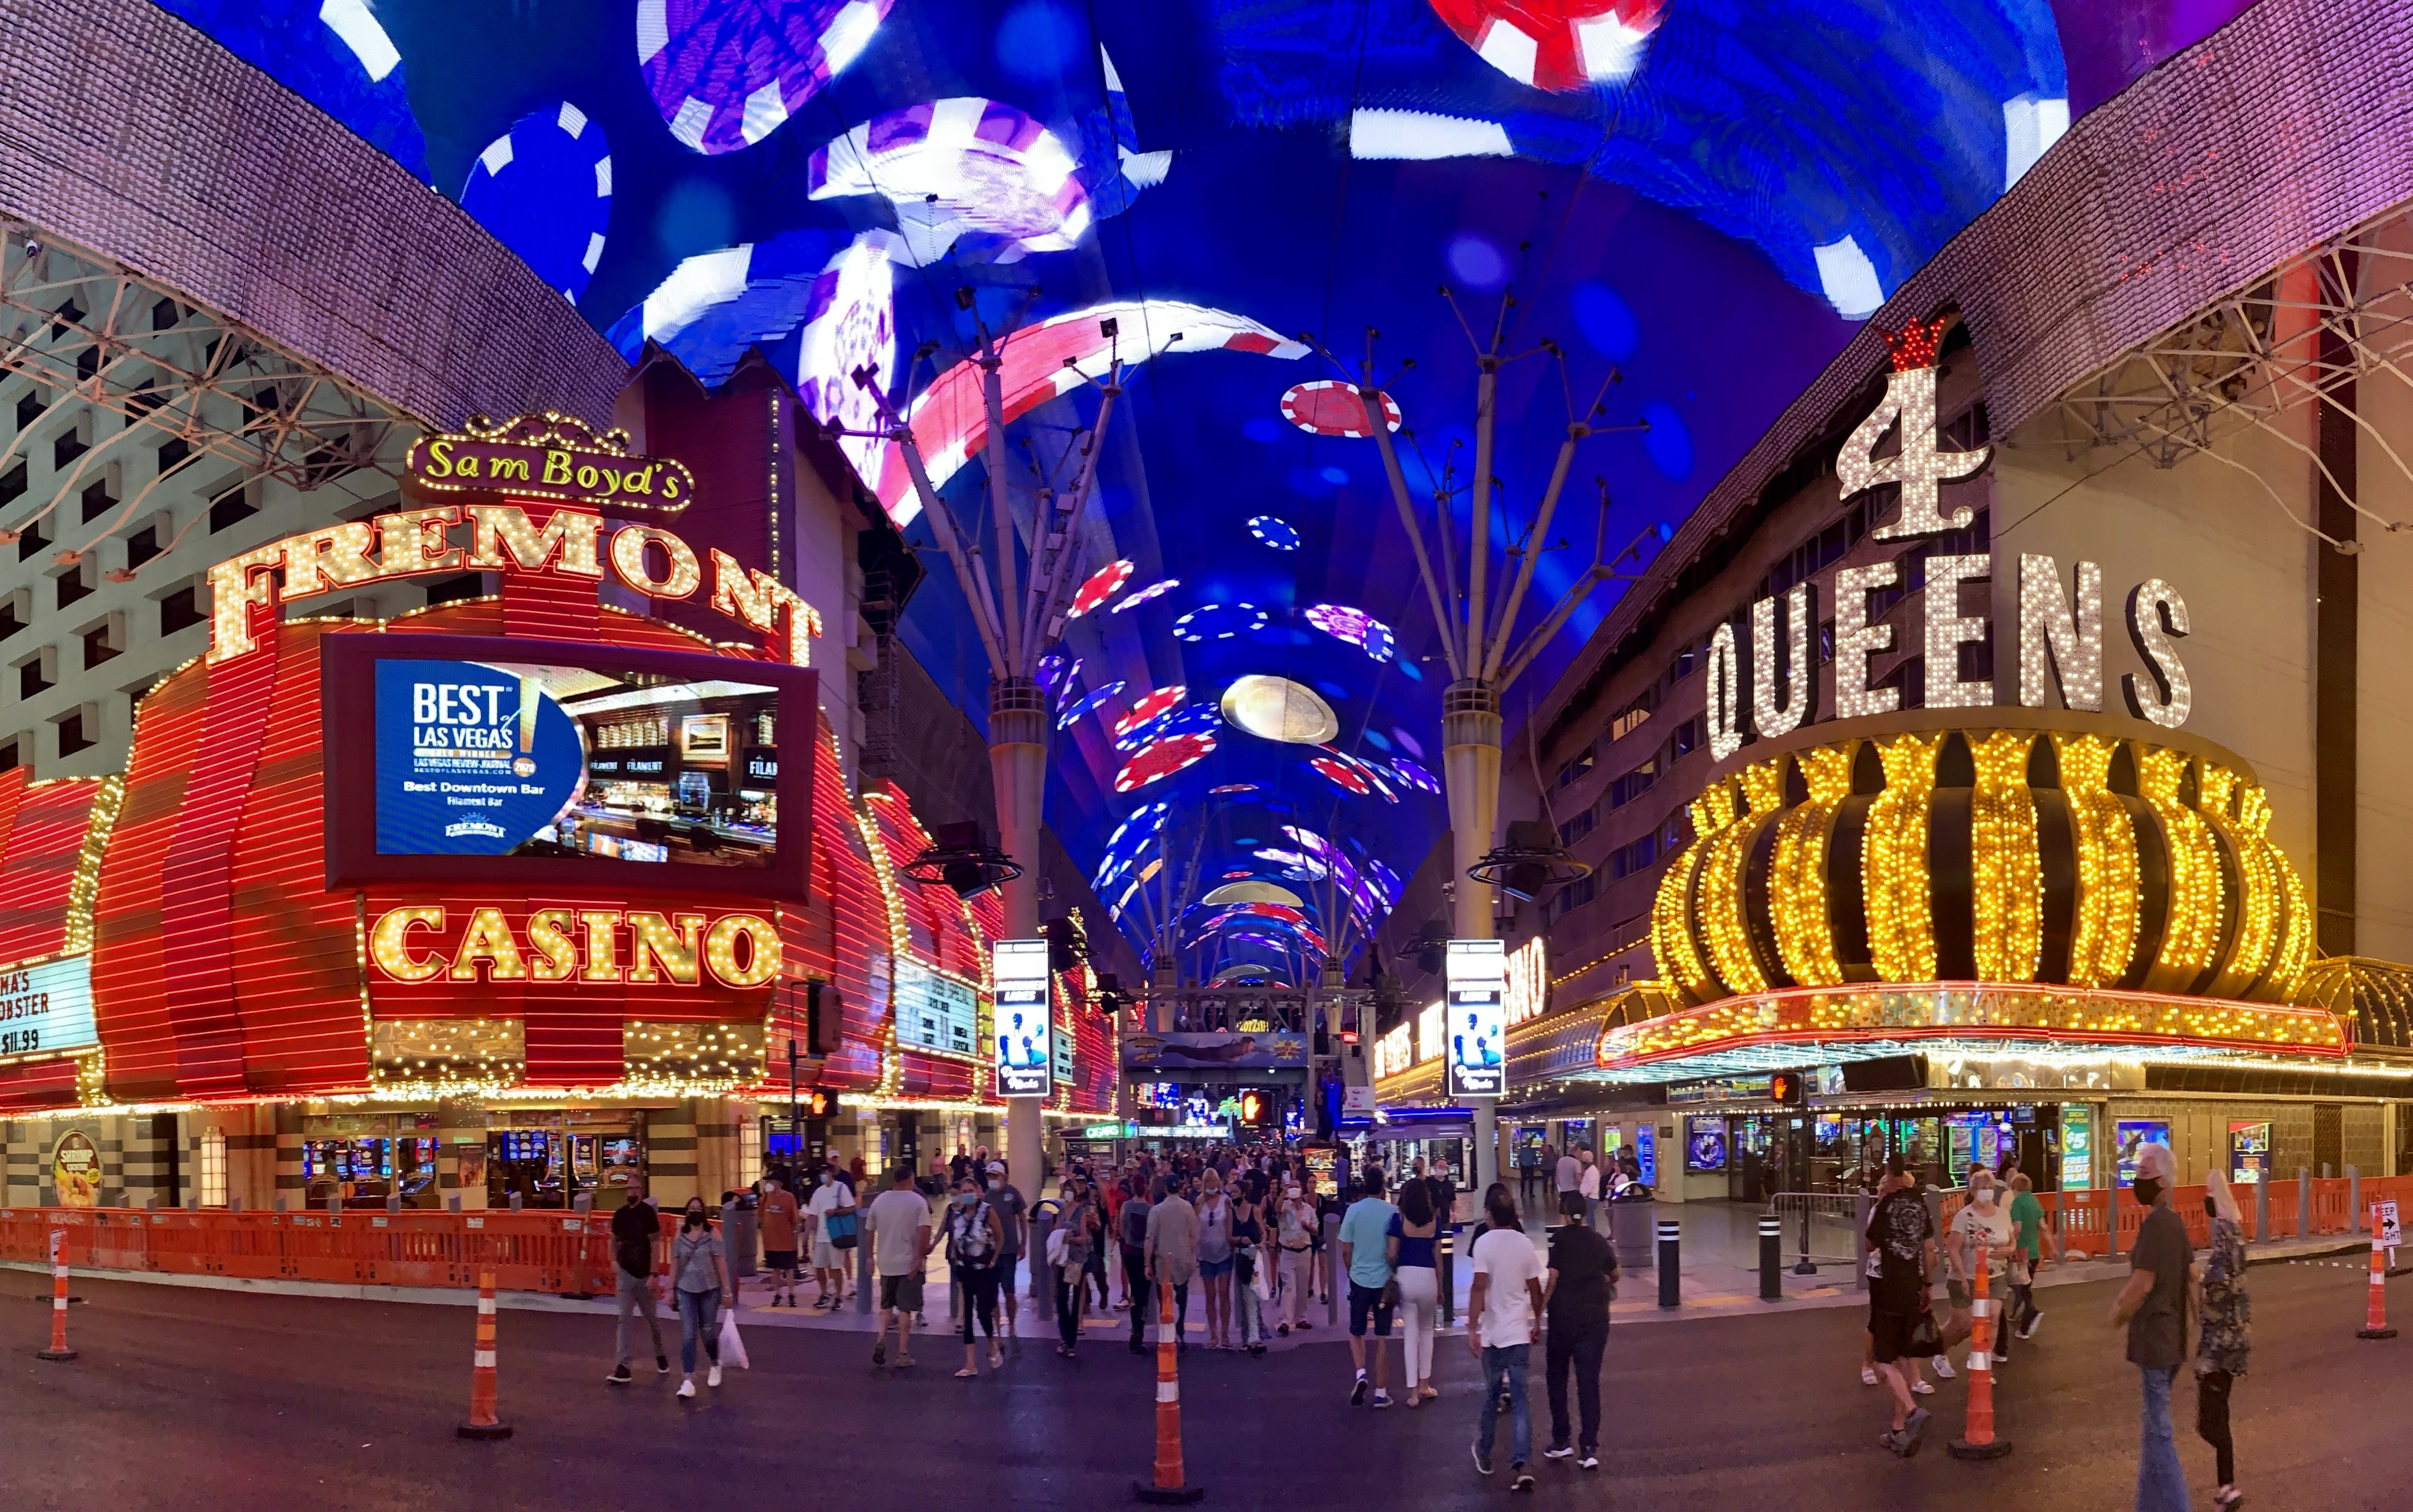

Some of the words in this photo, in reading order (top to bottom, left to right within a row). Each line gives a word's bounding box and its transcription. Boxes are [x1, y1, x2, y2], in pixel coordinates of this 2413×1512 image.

[1836, 366, 1995, 543] 4
[426, 440, 529, 479] Sam
[541, 450, 680, 499] Boyd's
[206, 505, 823, 669] FREMONT
[1707, 553, 2192, 763] QUEENS
[413, 683, 505, 725] BEST
[413, 727, 449, 747] LAS
[452, 728, 513, 749] VEGAS
[413, 758, 428, 767] LAS
[627, 761, 663, 771] FILAMENT
[403, 781, 437, 792] Best
[440, 782, 517, 794] Downtown
[521, 784, 545, 795] Bar
[447, 797, 486, 806] Filament
[488, 797, 503, 806] Bar
[445, 822, 507, 838] FREMONT
[369, 906, 783, 990] CASINO
[2, 1029, 38, 1055] $11.99
[1086, 1125, 1119, 1138] CIGARS
[2066, 1131, 2087, 1149] $5
[60, 1149, 94, 1163] SHRIMP
[2063, 1156, 2090, 1165] FREE
[2063, 1164, 2090, 1173] SLOT
[2063, 1173, 2090, 1182] PLAY
[2381, 1207, 2395, 1216] EEP
[2384, 1231, 2400, 1241] GHT
